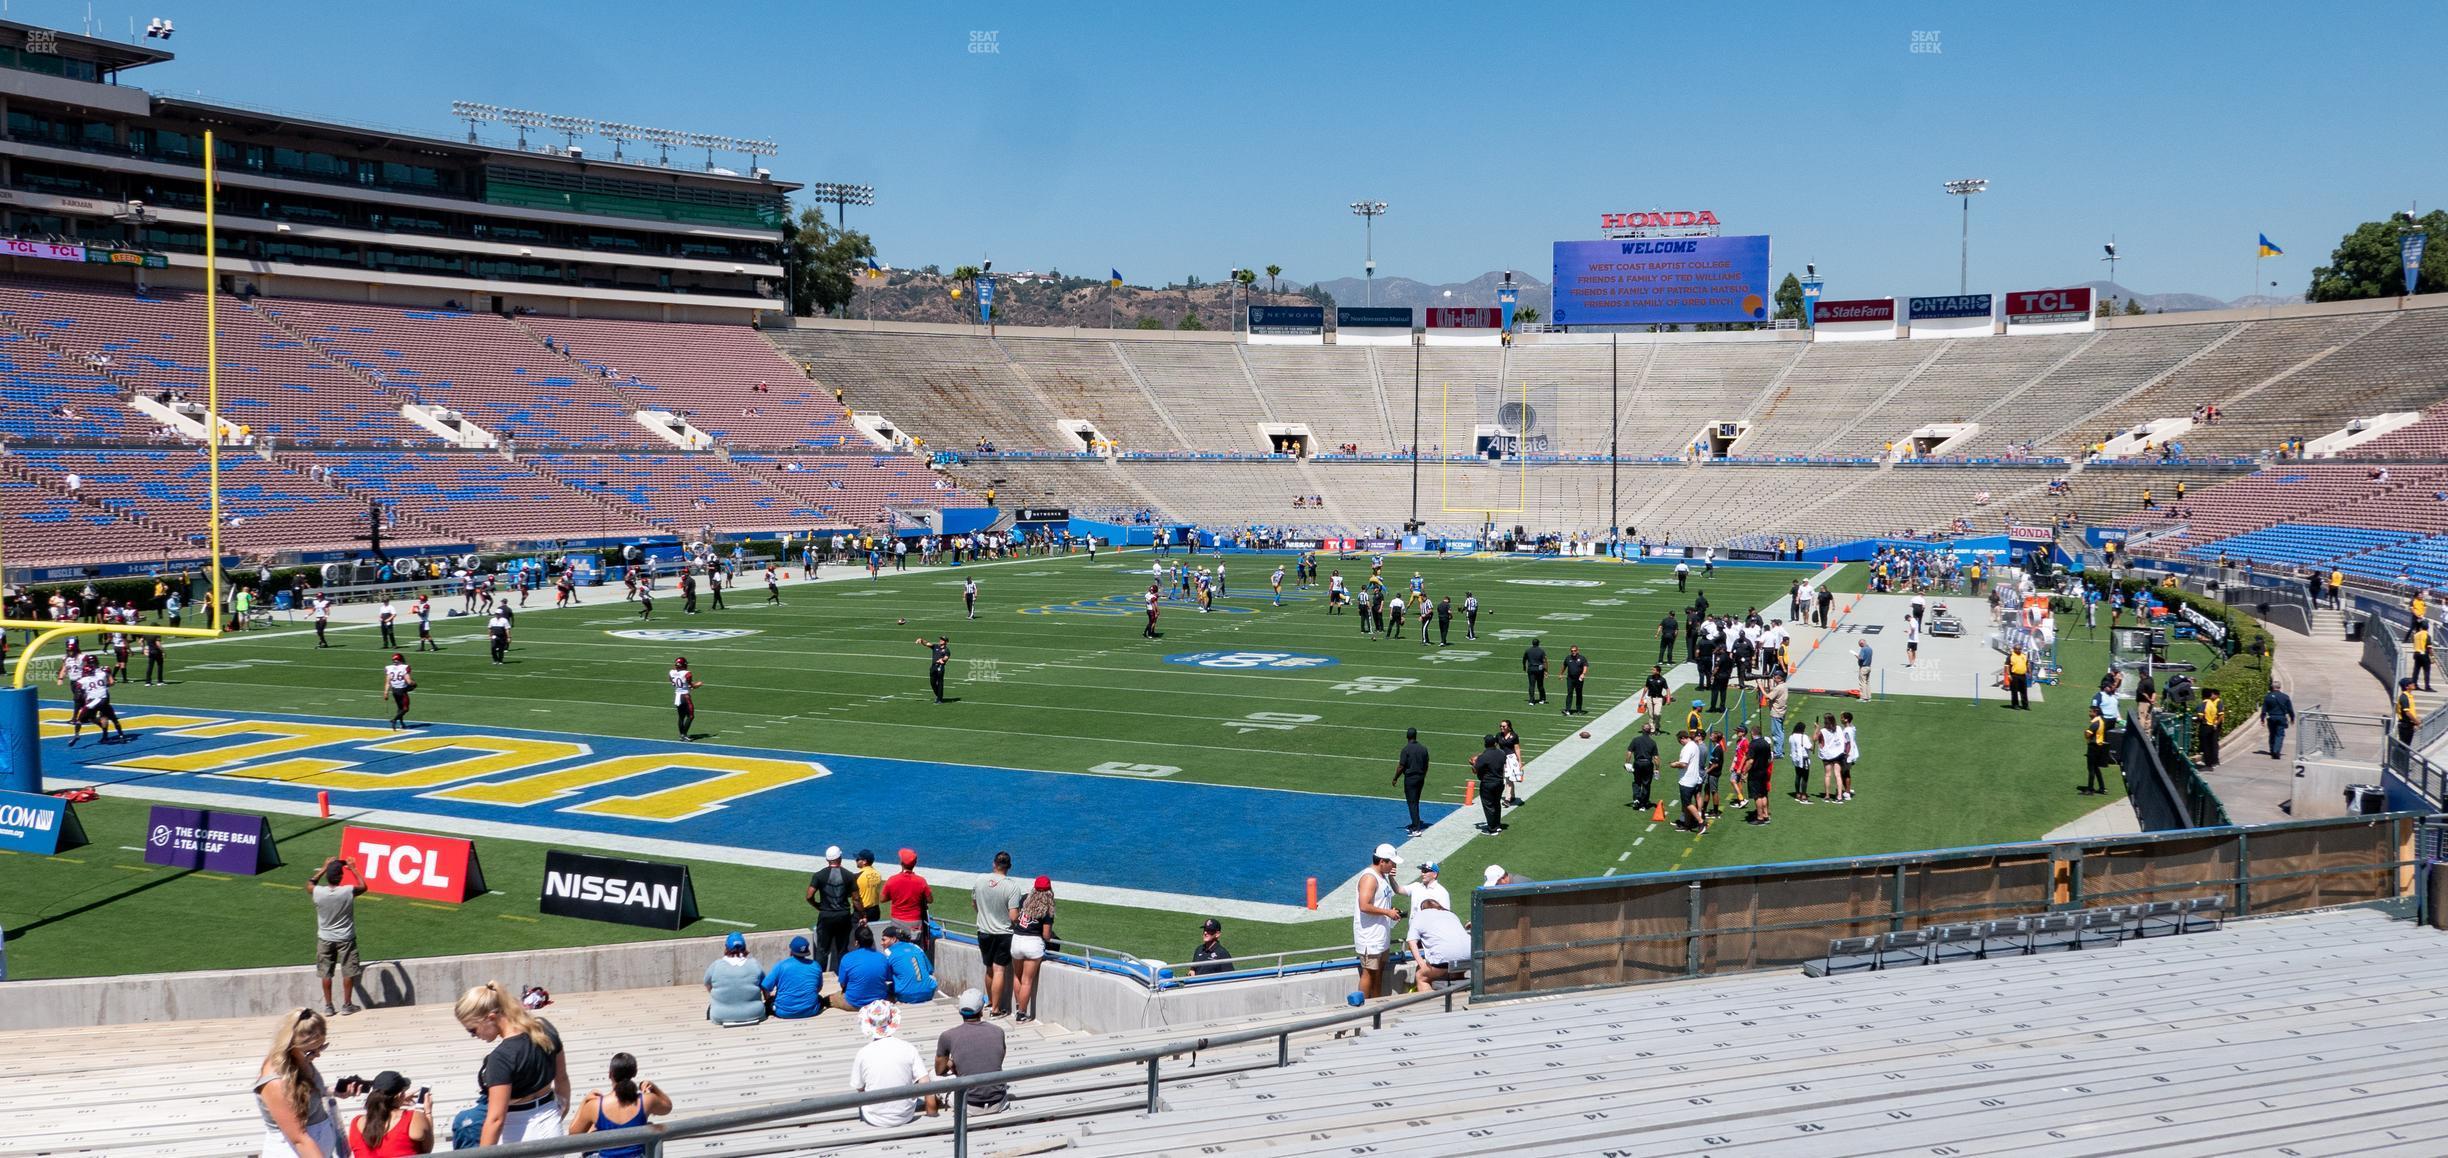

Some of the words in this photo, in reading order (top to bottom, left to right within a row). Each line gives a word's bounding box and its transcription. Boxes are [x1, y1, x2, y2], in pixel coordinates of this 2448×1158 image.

[1601, 211, 1720, 228] HONDA
[8, 242, 37, 252] TCL
[50, 245, 78, 257] TCL
[1622, 241, 1697, 255] WELCOME
[1648, 262, 1685, 270] BAPTIST
[1688, 260, 1732, 268] COLLEGE
[1578, 276, 1616, 284] FRIENDS
[1626, 274, 1658, 282] FAMILY
[1661, 274, 1672, 282] OF
[1695, 272, 1742, 280] WILLIAMS
[1569, 288, 1608, 296] FRIENDS
[1911, 296, 1990, 312] ONTARIO
[2020, 293, 2075, 311] TCL
[1721, 424, 1736, 435] 40
[2011, 527, 2051, 539] HONDA
[48, 568, 72, 578] MUSCLE
[2296, 766, 2304, 778] 2
[176, 826, 192, 838] THE
[194, 828, 228, 842] COFFEE
[230, 831, 256, 844] BEAN
[180, 840, 198, 850] TEA
[200, 842, 223, 854] LEAF
[358, 842, 449, 888] TCL
[545, 871, 678, 911] NISSAN
[1688, 1098, 1713, 1106] 13
[1980, 1099, 2006, 1107] 10
[1584, 1113, 1609, 1121] 14
[1887, 1112, 1913, 1120] 11
[1794, 1124, 1825, 1133] 12
[1467, 1130, 1494, 1138] 15
[2387, 1132, 2408, 1140] 7
[1703, 1137, 1732, 1145] 13
[1201, 1146, 1227, 1154] 18
[1351, 1146, 1378, 1154] 16
[1931, 1147, 1960, 1156] 10
